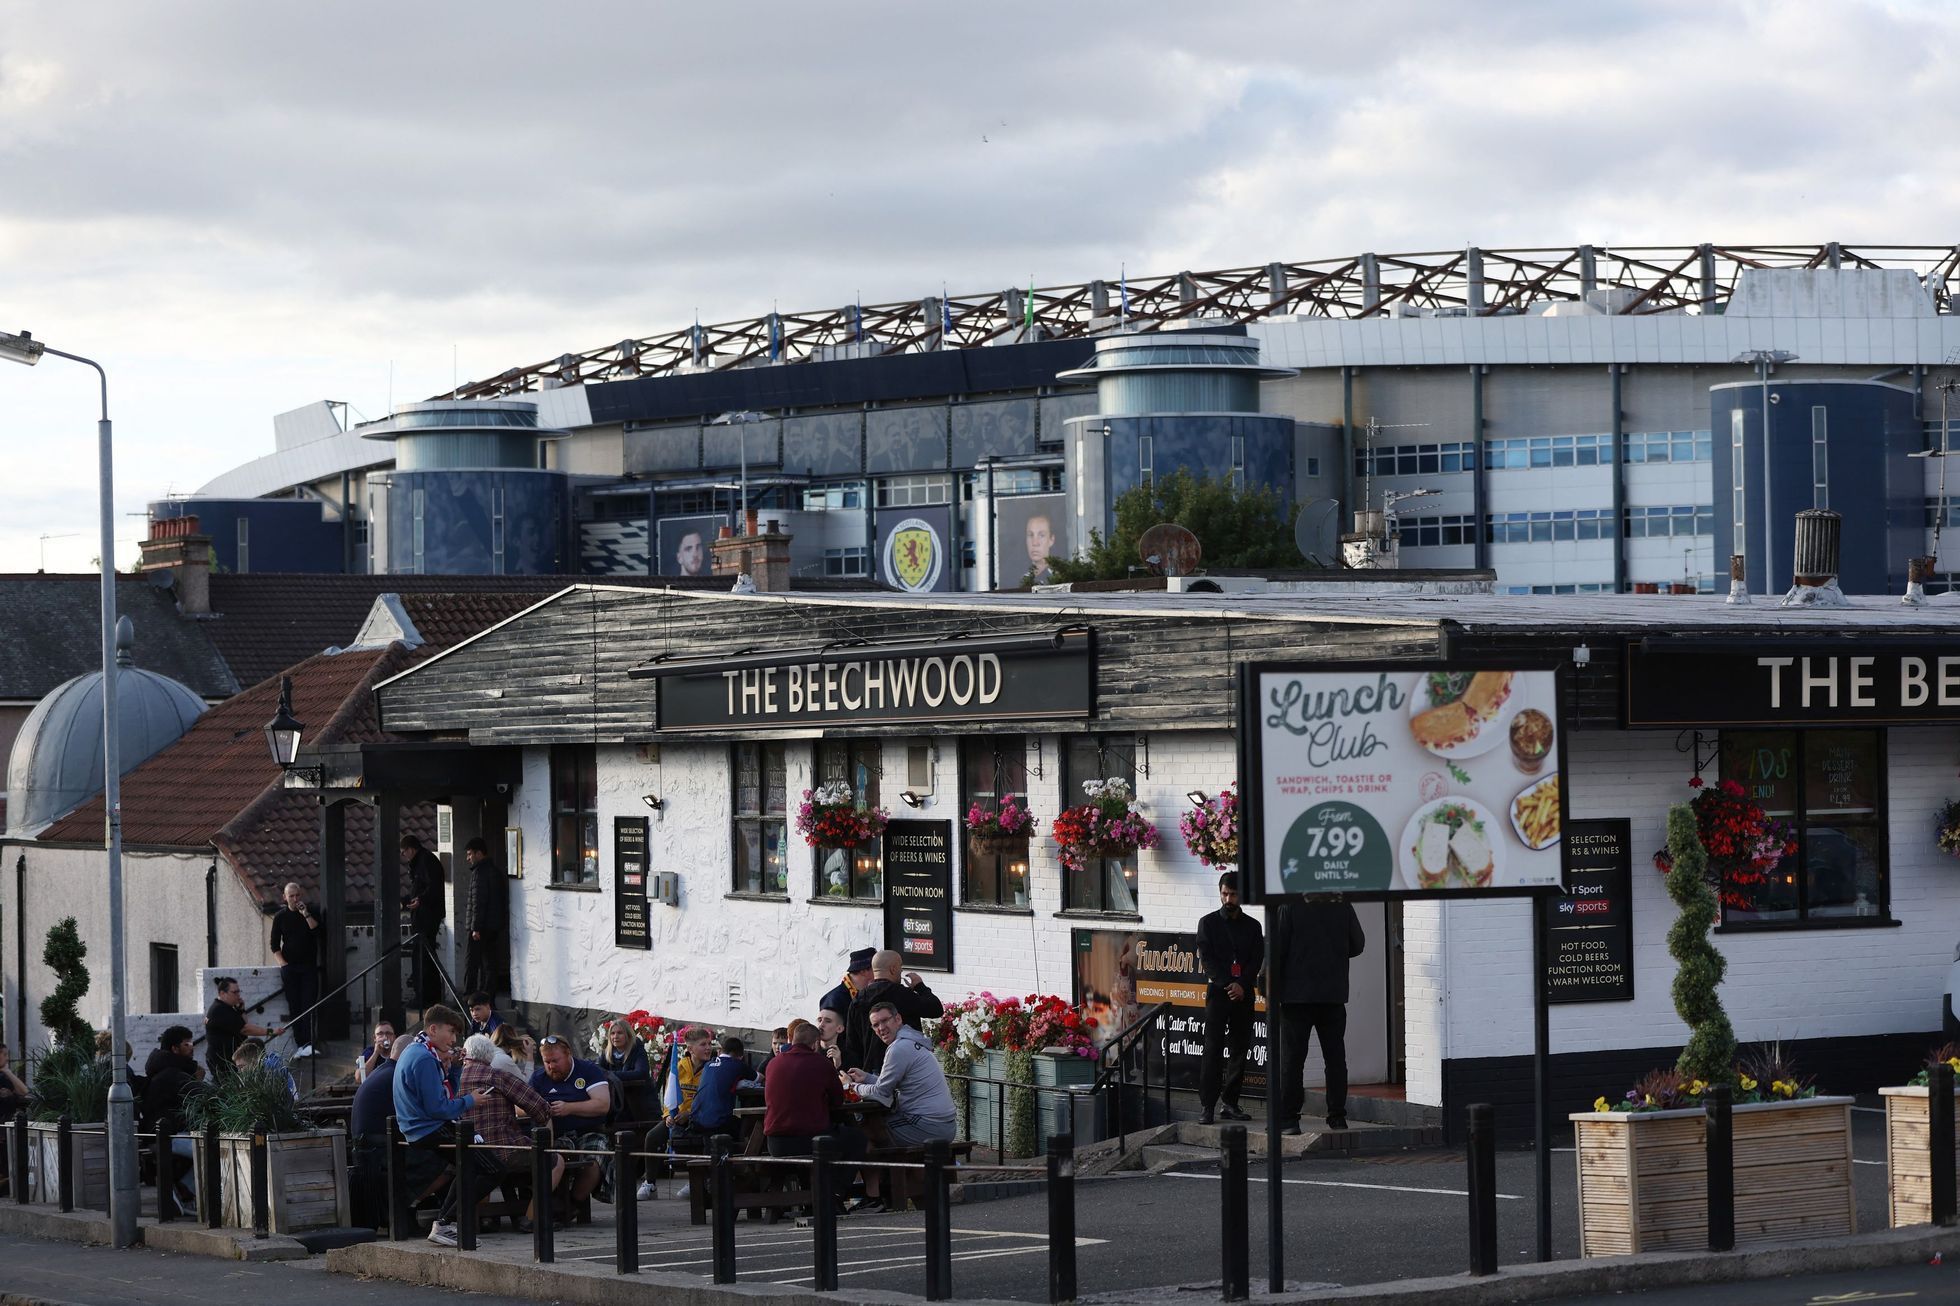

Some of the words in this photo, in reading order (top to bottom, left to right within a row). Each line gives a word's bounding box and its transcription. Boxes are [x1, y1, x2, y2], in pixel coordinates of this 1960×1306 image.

[722, 667, 778, 715] THE
[788, 653, 1002, 713] BEECHWOOD
[1757, 656, 1876, 708] THE
[1266, 672, 1406, 736] Lunch
[1308, 721, 1388, 768] Club
[1748, 748, 1792, 780] IDS
[1276, 776, 1332, 785] SANDWICH,
[1336, 774, 1374, 784] TOASTIE
[1378, 774, 1392, 782] OR
[1280, 786, 1312, 795] WRAP,
[1315, 785, 1344, 794] CHIPS
[1347, 785, 1354, 793] &
[1357, 784, 1388, 792] DRINK
[1318, 808, 1353, 826] From
[892, 836, 908, 846] WIDE
[909, 836, 943, 847] SELECTION
[1307, 826, 1364, 857] 7.99
[1570, 835, 1616, 844] SELECTION
[1592, 846, 1620, 854] WINES
[890, 851, 899, 861] OF
[900, 851, 917, 862] BEERS
[918, 852, 923, 862] &
[924, 852, 946, 863] WINES
[1324, 860, 1350, 870] DAILY
[1314, 870, 1341, 880] UNTIL
[892, 886, 924, 897] FUNCTION
[925, 887, 943, 898] ROOM
[1578, 884, 1603, 895] Sport
[1560, 903, 1574, 914] sky
[1577, 902, 1608, 912] sports
[915, 922, 930, 932] Sport
[904, 940, 913, 951] sky
[914, 941, 933, 951] sports
[1561, 942, 1579, 950] HOT
[1136, 940, 1194, 974] Function
[1559, 954, 1583, 962] COLD
[1585, 952, 1609, 961] BEERS
[1548, 965, 1593, 975] FUNCTION
[1596, 964, 1620, 973] ROOM
[1553, 978, 1580, 986] WARM
[1582, 975, 1624, 984] WELCOME
[1139, 988, 1164, 998] WEDDINGS
[1170, 990, 1196, 999] BIRTHDAYS
[1188, 1017, 1200, 1033] For
[1182, 1040, 1204, 1056] Value
